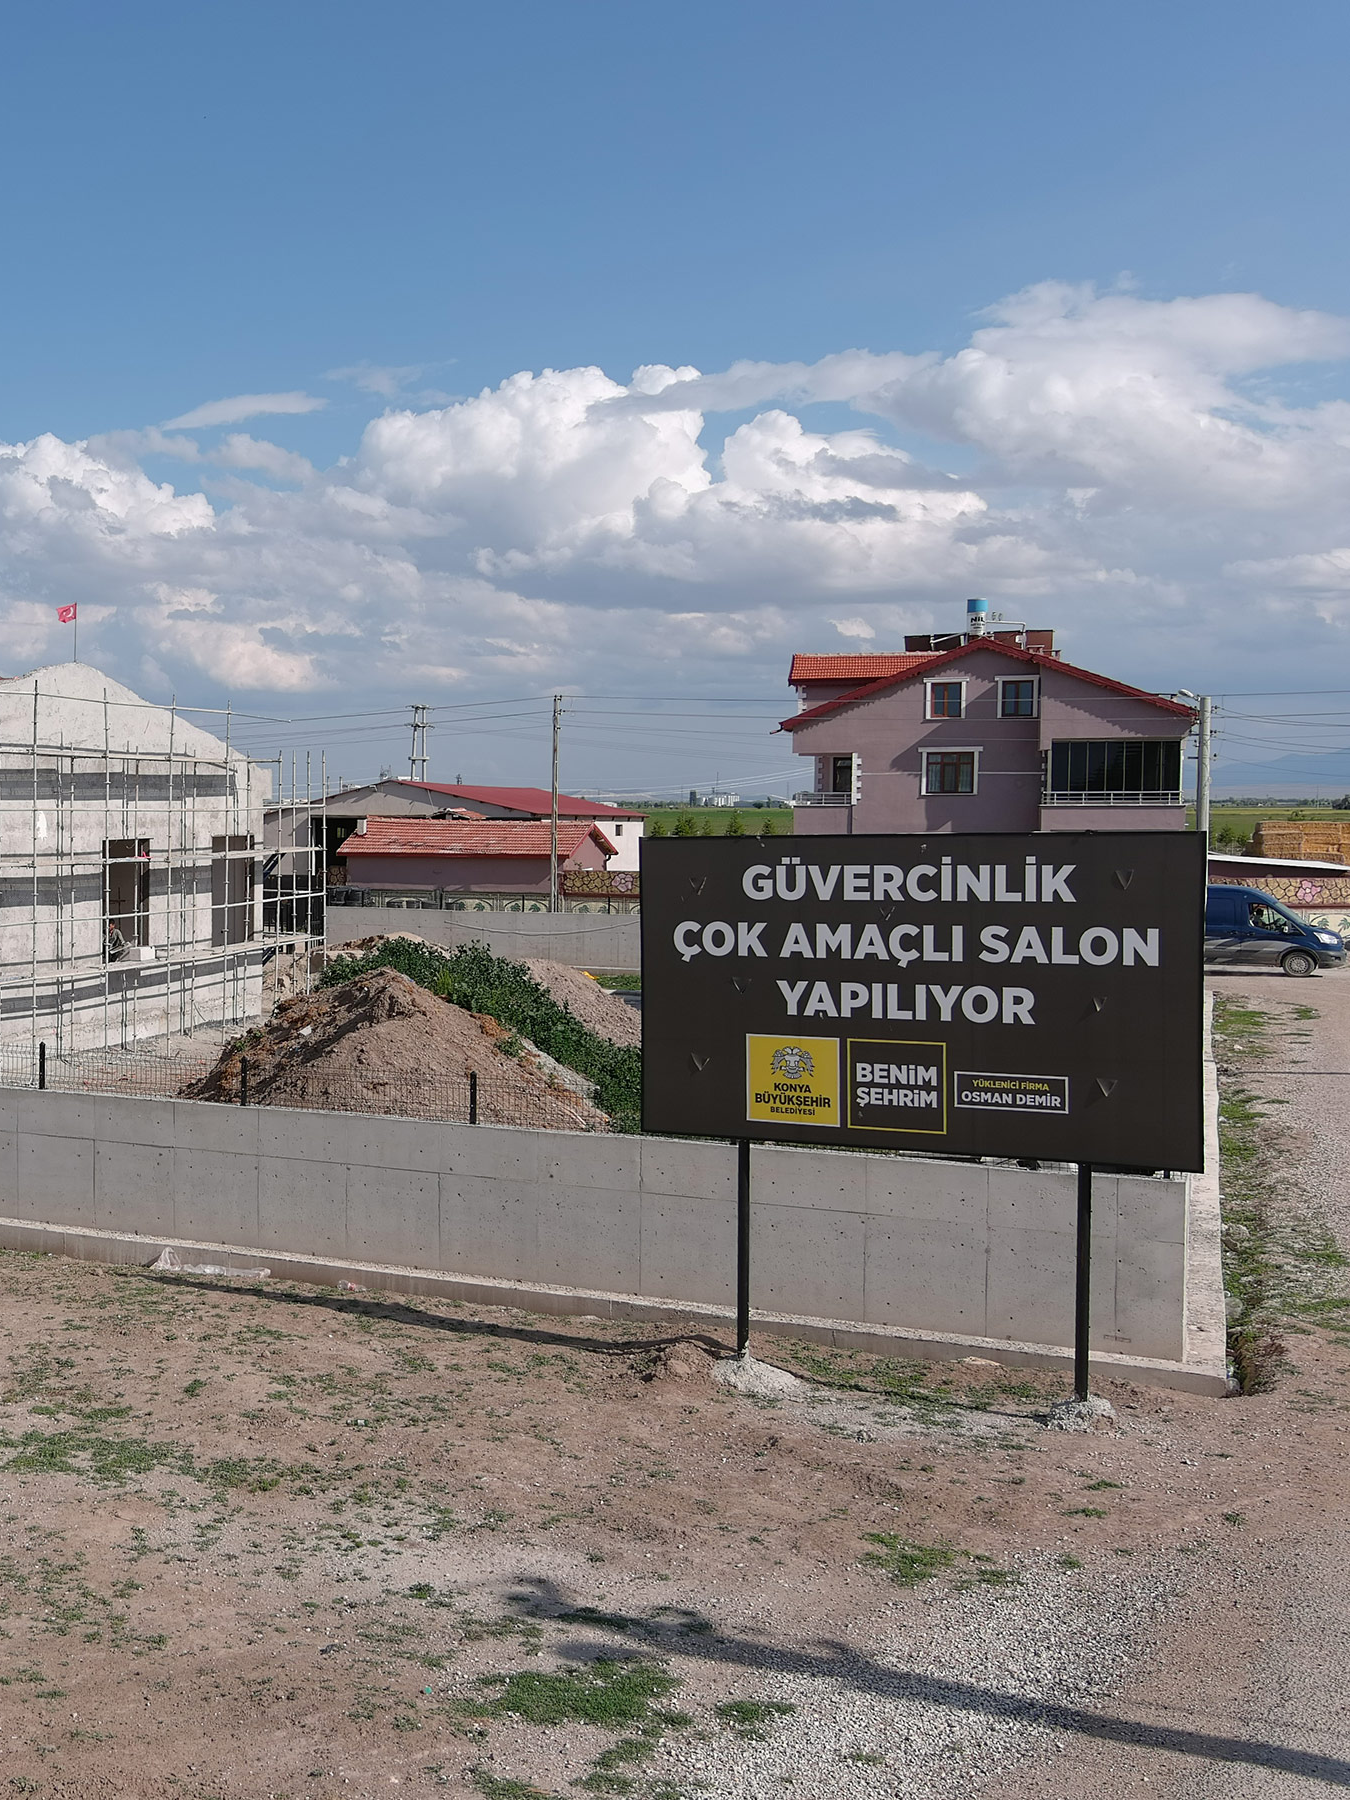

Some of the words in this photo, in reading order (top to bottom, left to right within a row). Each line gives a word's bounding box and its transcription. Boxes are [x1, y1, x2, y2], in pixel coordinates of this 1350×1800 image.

[742, 856, 1077, 903] GÜVERCİNLİK
[673, 920, 768, 963] ÇOK
[780, 923, 964, 969] AMAÇLI
[978, 925, 1160, 967] SALON
[775, 979, 1036, 1025] YAPILIYOR
[773, 1082, 812, 1093] KONYA
[972, 1079, 1020, 1090] YÜKLENİCİ
[1021, 1080, 1050, 1091] FİRMA
[755, 1091, 831, 1108] BÜYÜKŞEHİR
[961, 1091, 1013, 1105] OSMAN
[1016, 1093, 1061, 1107] DEMİR
[770, 1106, 816, 1116] BELEDİYESİ
